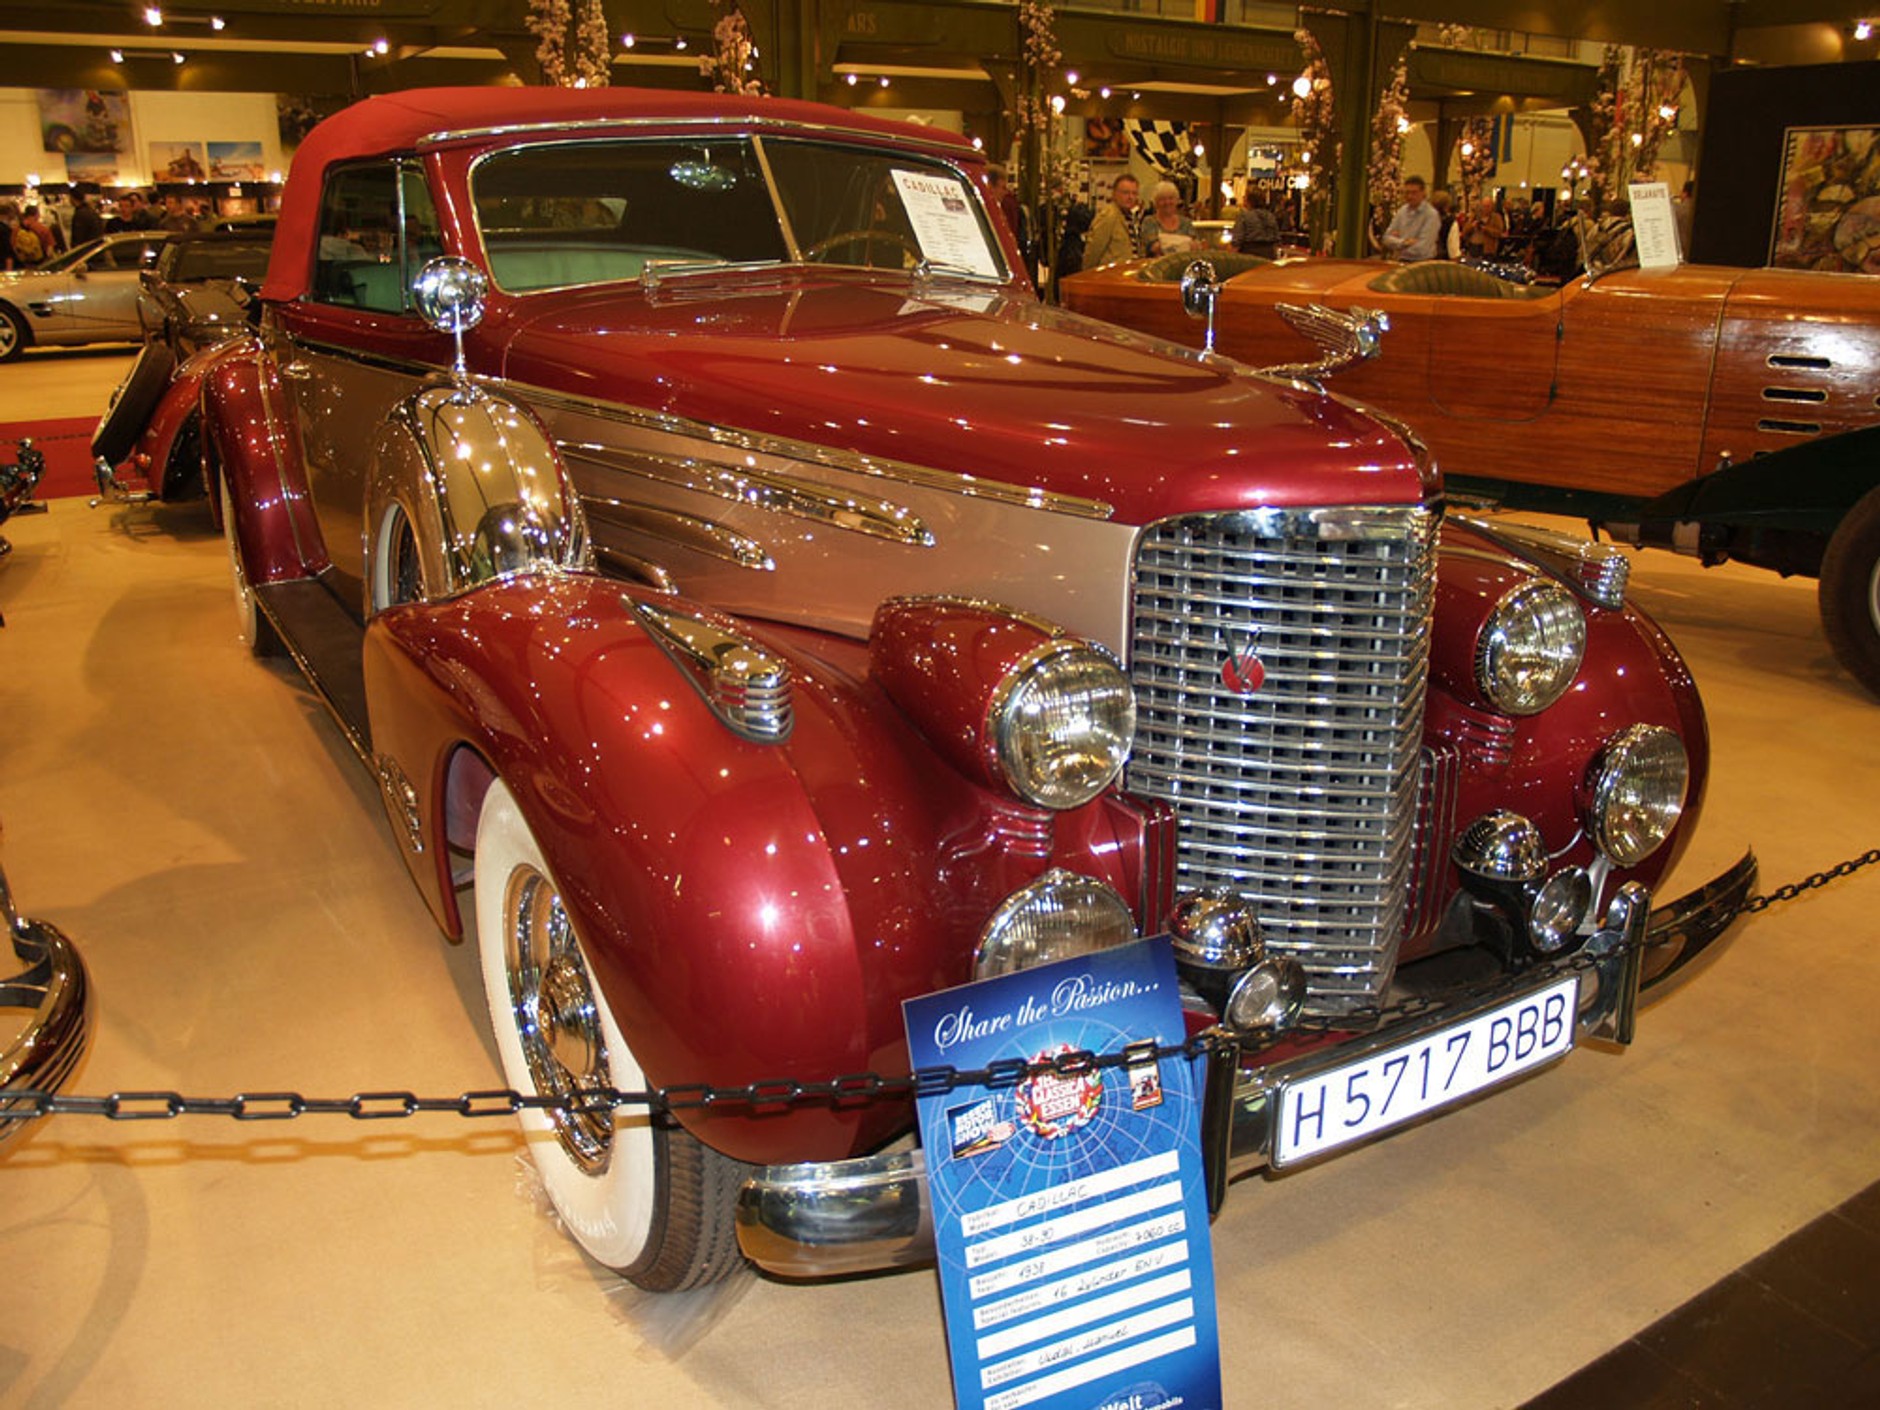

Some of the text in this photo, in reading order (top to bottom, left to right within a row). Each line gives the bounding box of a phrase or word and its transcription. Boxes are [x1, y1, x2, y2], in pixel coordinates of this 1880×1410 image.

[902, 178, 957, 197] CADILLAC
[934, 973, 1160, 1055] Share the Passion...
[1293, 992, 1566, 1147] H 5717 BBB
[1032, 1076, 1085, 1105] CLASSICA
[1042, 1096, 1081, 1116] ESSEN
[1016, 1184, 1088, 1217] CADILLAC
[1018, 1261, 1045, 1281] 1938
[1053, 1284, 1067, 1298] 16
